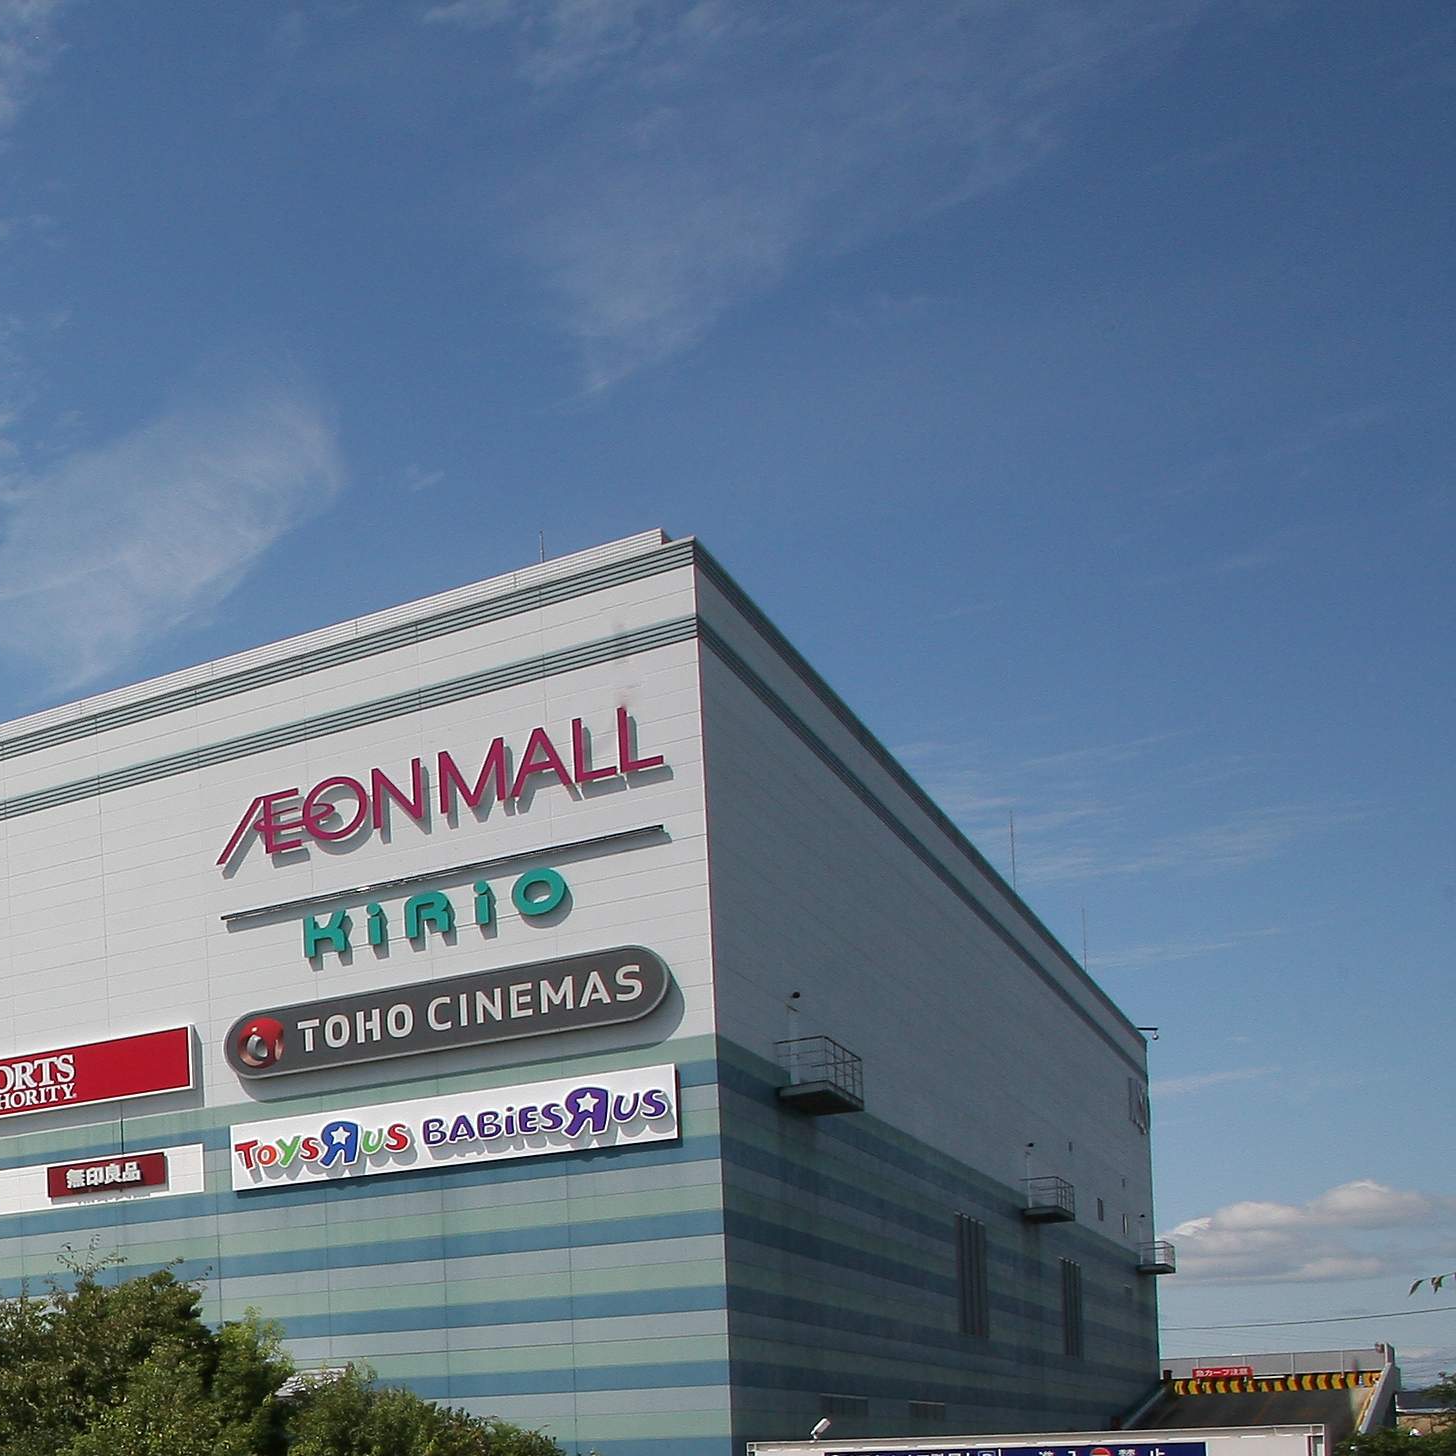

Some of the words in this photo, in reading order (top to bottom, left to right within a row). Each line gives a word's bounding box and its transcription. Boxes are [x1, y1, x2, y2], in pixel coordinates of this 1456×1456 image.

[437, 707, 664, 814] MALL
[296, 1003, 414, 1053] TOHO
[427, 965, 645, 1031] CINEMAS
[66, 1162, 141, 1188] 無印良品
